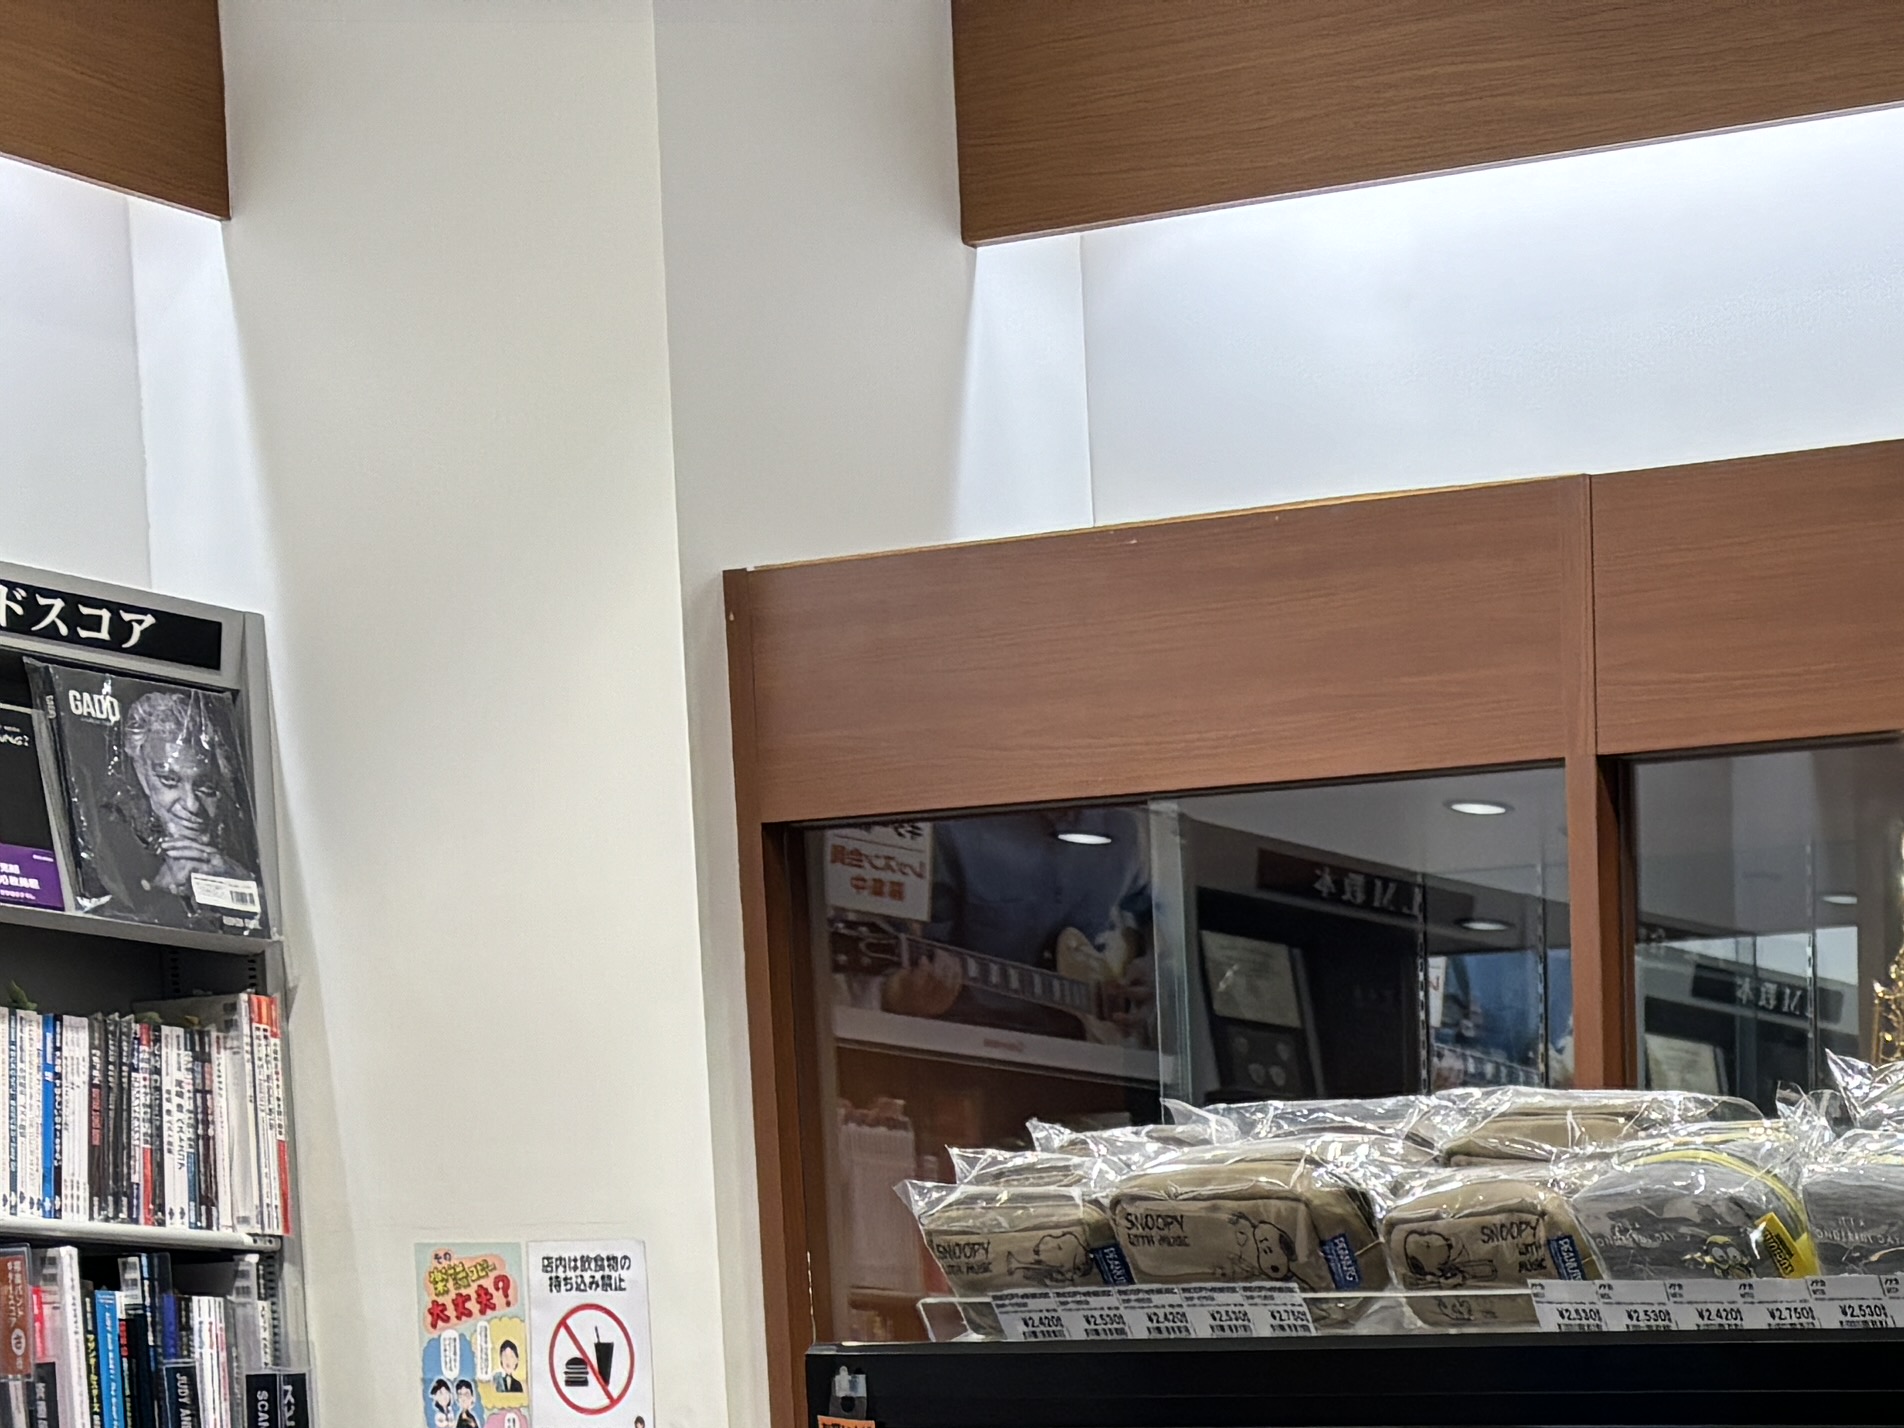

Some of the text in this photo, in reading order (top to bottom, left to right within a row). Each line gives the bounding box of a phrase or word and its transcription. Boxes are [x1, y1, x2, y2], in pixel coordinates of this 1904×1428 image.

[1125, 1213, 1186, 1233] SNOOPY
[1480, 1218, 1543, 1244] SNOOPY
[935, 1243, 991, 1261] SNOOPY
[542, 1254, 632, 1274] 店内は飲食物の
[549, 1274, 627, 1293] 持ち込み禁止
[176, 1373, 191, 1405] JUDY
